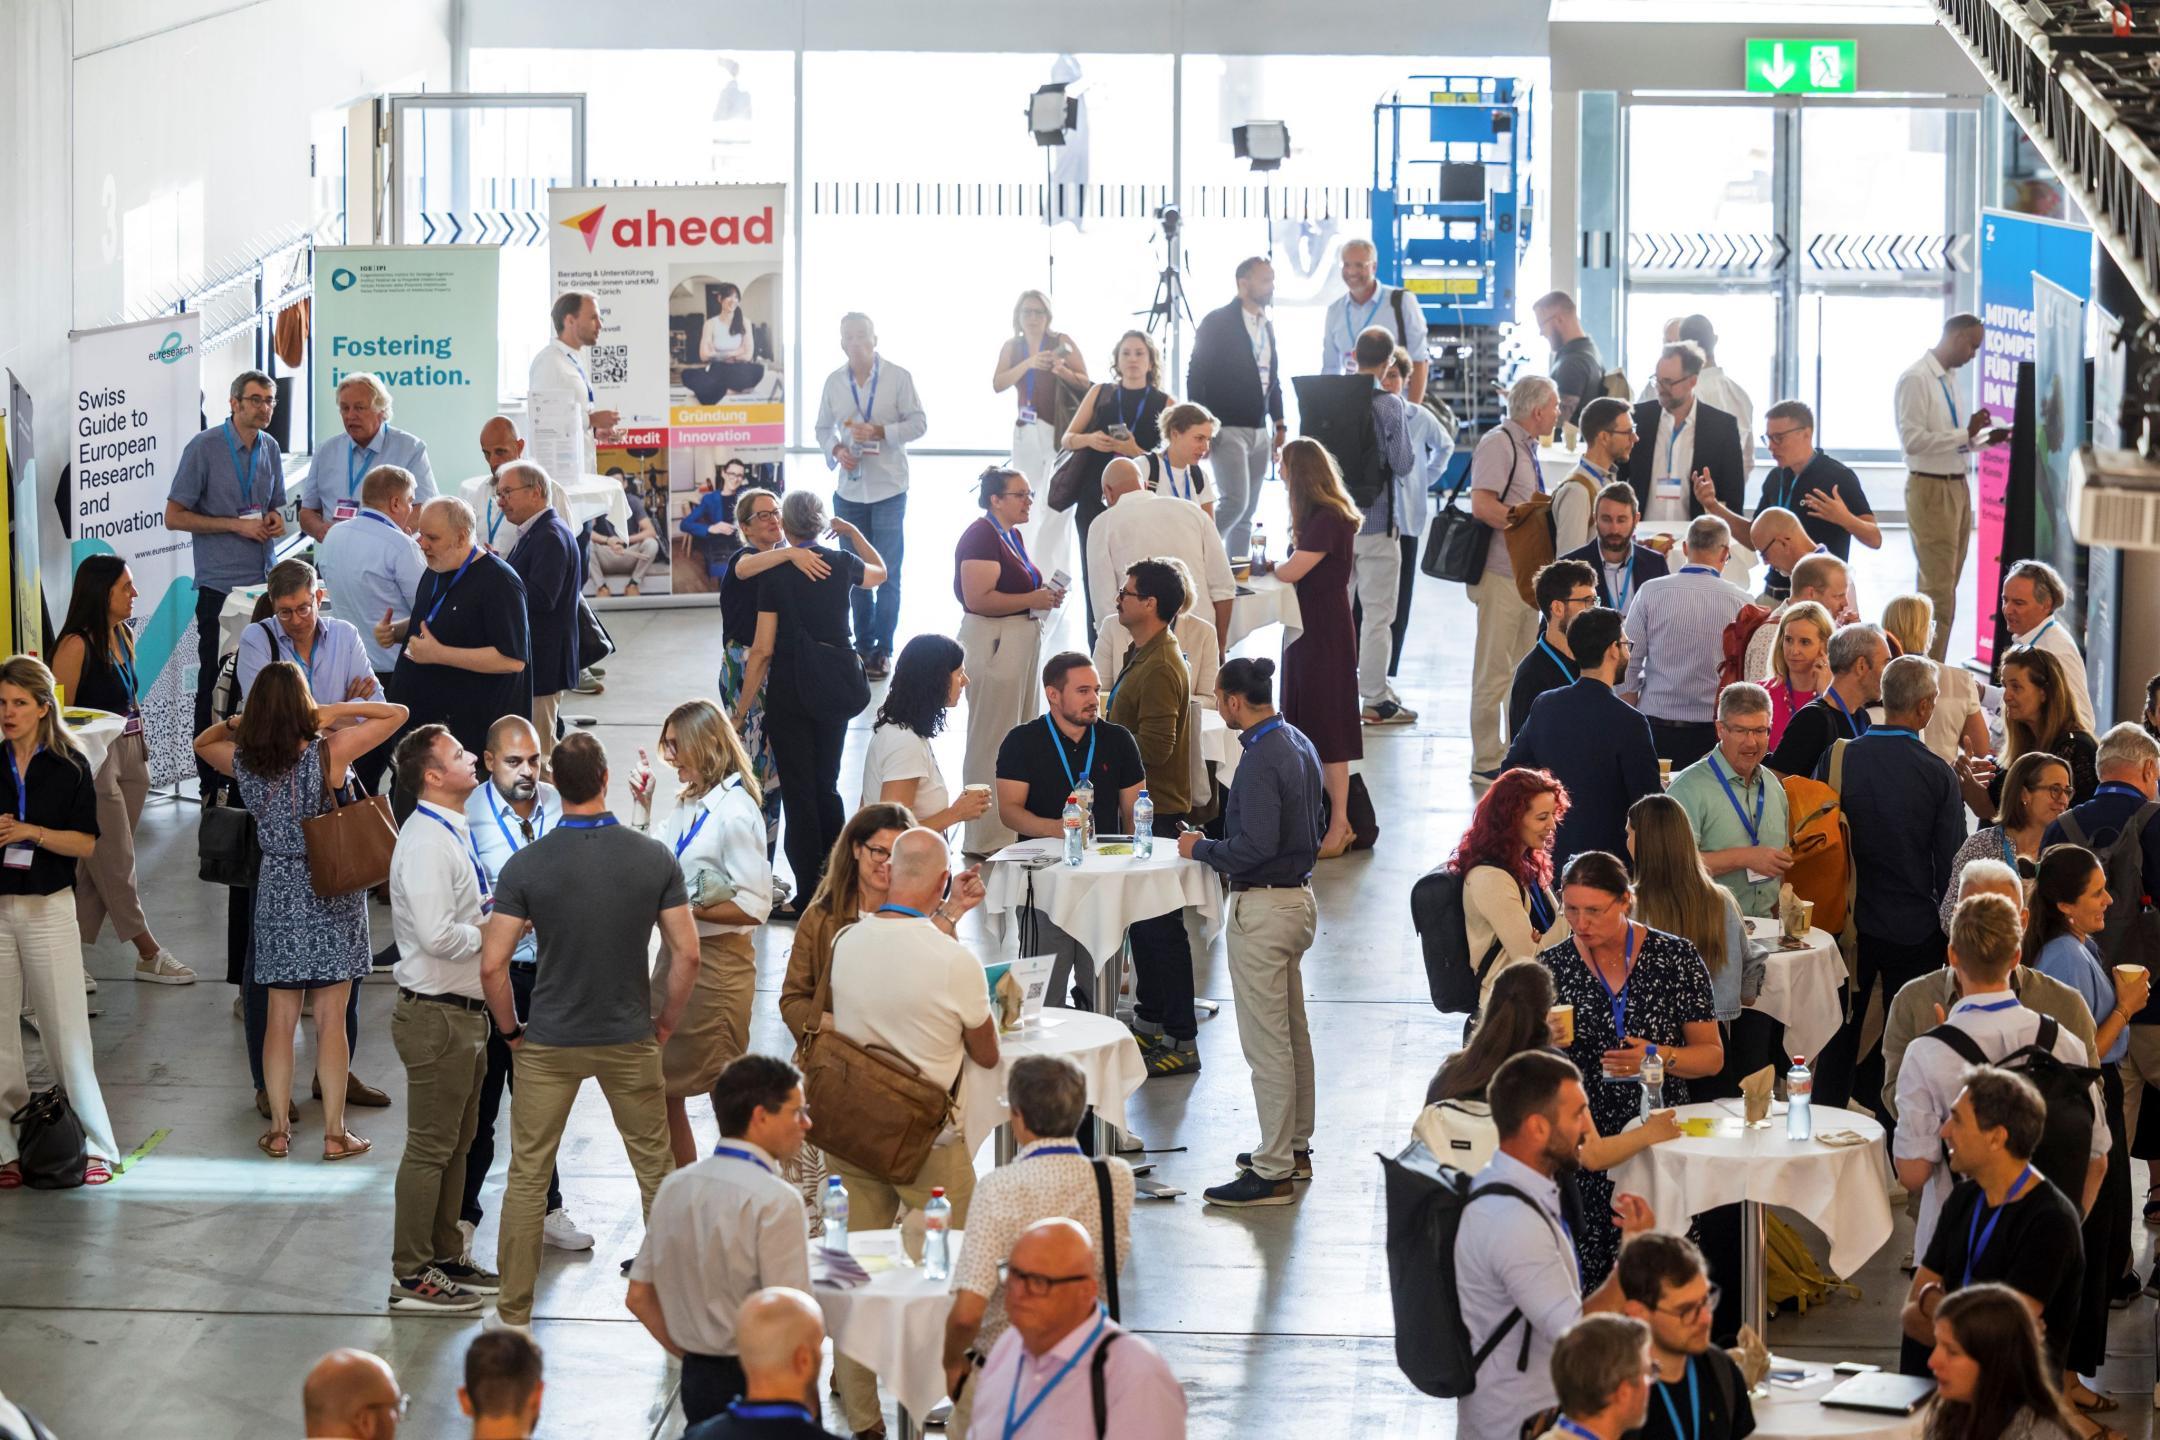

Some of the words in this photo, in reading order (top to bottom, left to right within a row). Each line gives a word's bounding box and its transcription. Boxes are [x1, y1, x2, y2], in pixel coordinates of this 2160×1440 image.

[612, 206, 773, 248] ahead
[1499, 213, 1512, 233] 8
[558, 271, 592, 279] Beratung
[600, 269, 654, 277] Unterstützung
[558, 280, 569, 288] für
[625, 278, 639, 286] und
[148, 343, 194, 361] euresearch
[333, 334, 452, 359] Fostering
[333, 365, 471, 387] iovation.
[78, 387, 126, 411] Swiss
[78, 411, 127, 437] Guide
[131, 409, 148, 428] to
[678, 410, 747, 424] Gründung
[597, 431, 660, 445] kredit
[678, 430, 751, 443] Innovation
[79, 435, 157, 464] European
[80, 458, 154, 490] Research
[80, 491, 110, 517] and
[80, 510, 164, 540] Innovation
